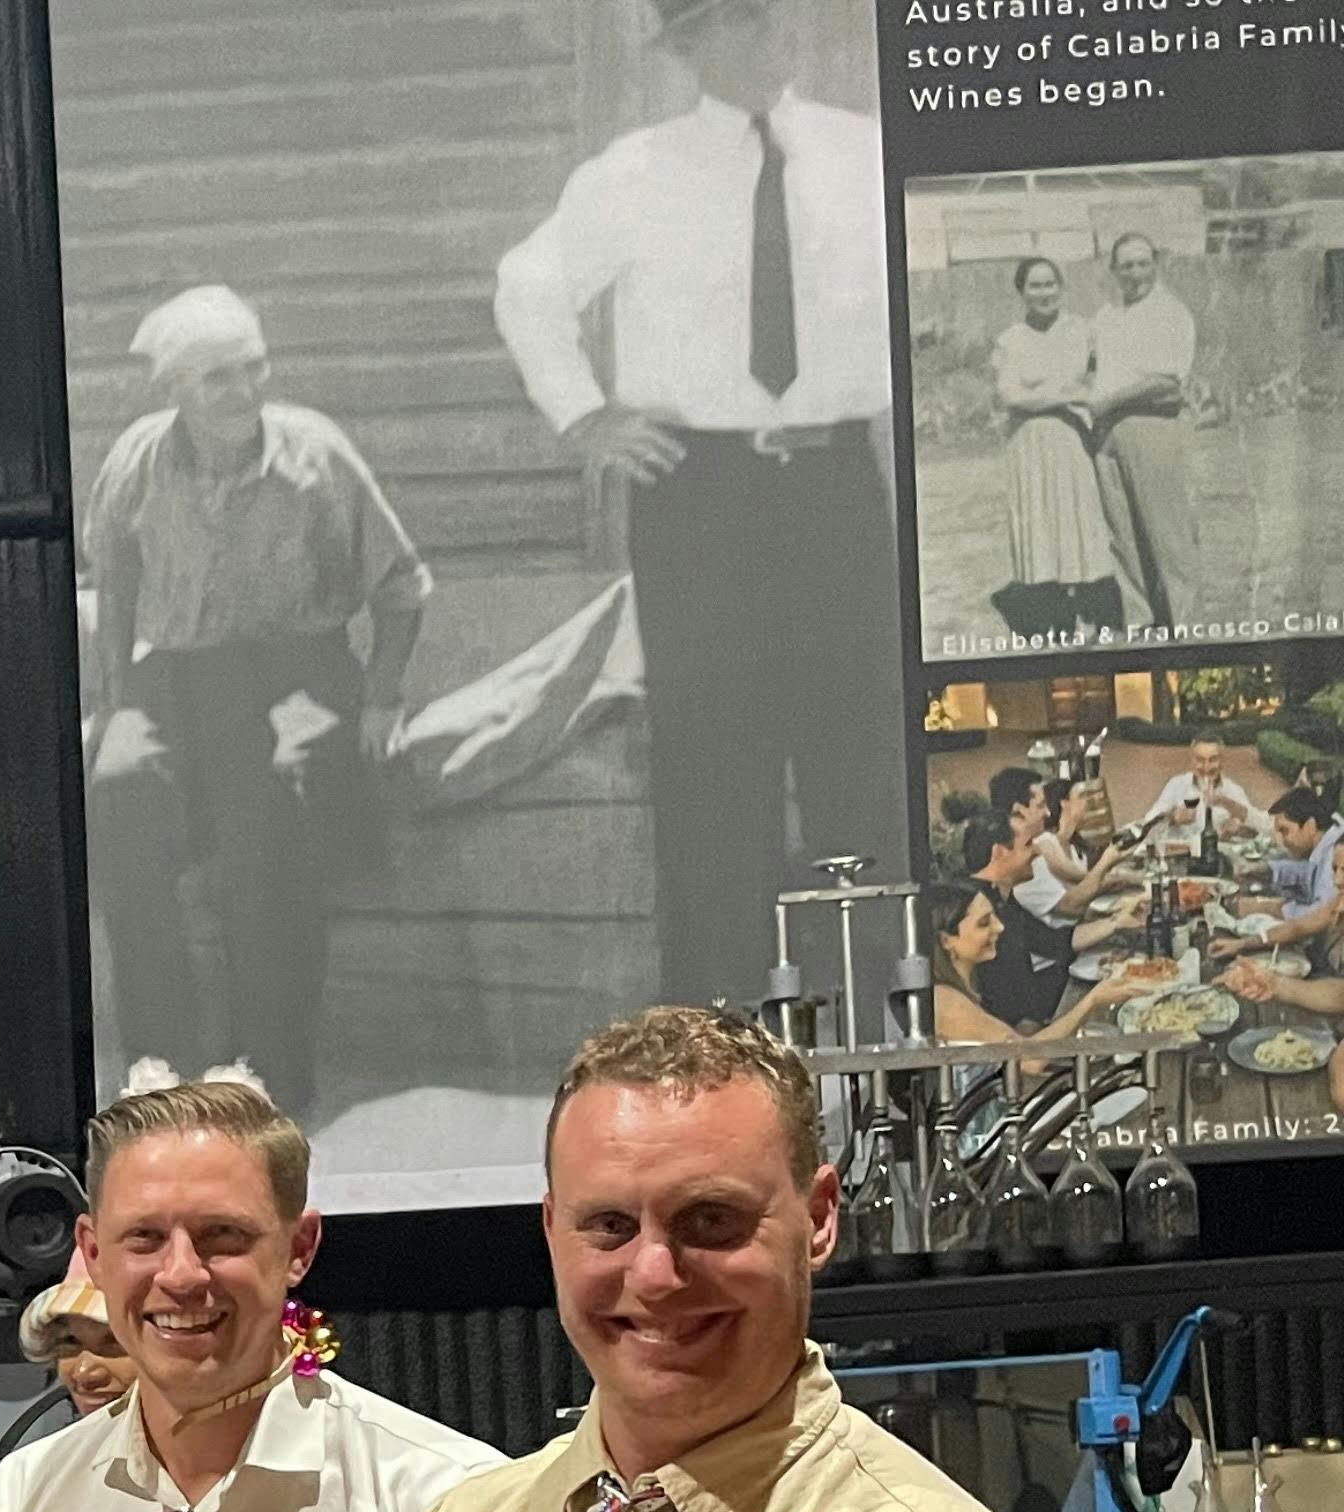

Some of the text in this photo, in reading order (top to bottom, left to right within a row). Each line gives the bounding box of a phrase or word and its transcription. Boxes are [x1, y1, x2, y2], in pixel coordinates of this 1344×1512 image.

[907, 41, 1001, 69] story
[1017, 35, 1052, 61] of
[1068, 26, 1220, 58] Calabria
[909, 76, 1166, 113] Wines began.
[1284, 611, 1344, 632] Cala
